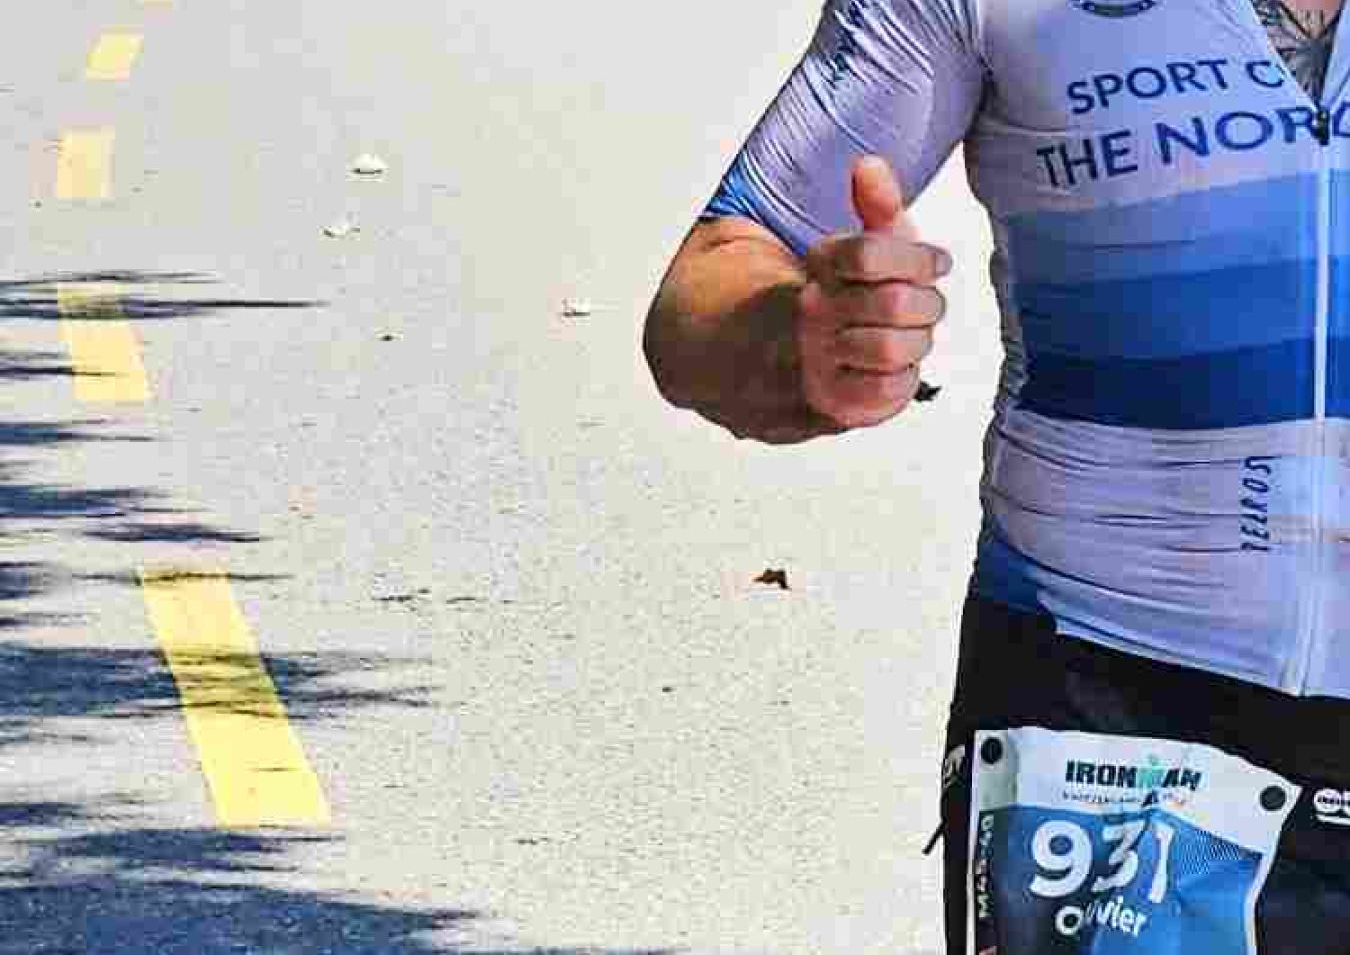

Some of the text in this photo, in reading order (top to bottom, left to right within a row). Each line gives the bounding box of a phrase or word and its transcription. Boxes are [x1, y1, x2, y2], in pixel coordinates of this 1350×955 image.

[1066, 58, 1228, 116] SPORT
[1036, 129, 1138, 188] THE
[1065, 757, 1203, 792] IRONMAN
